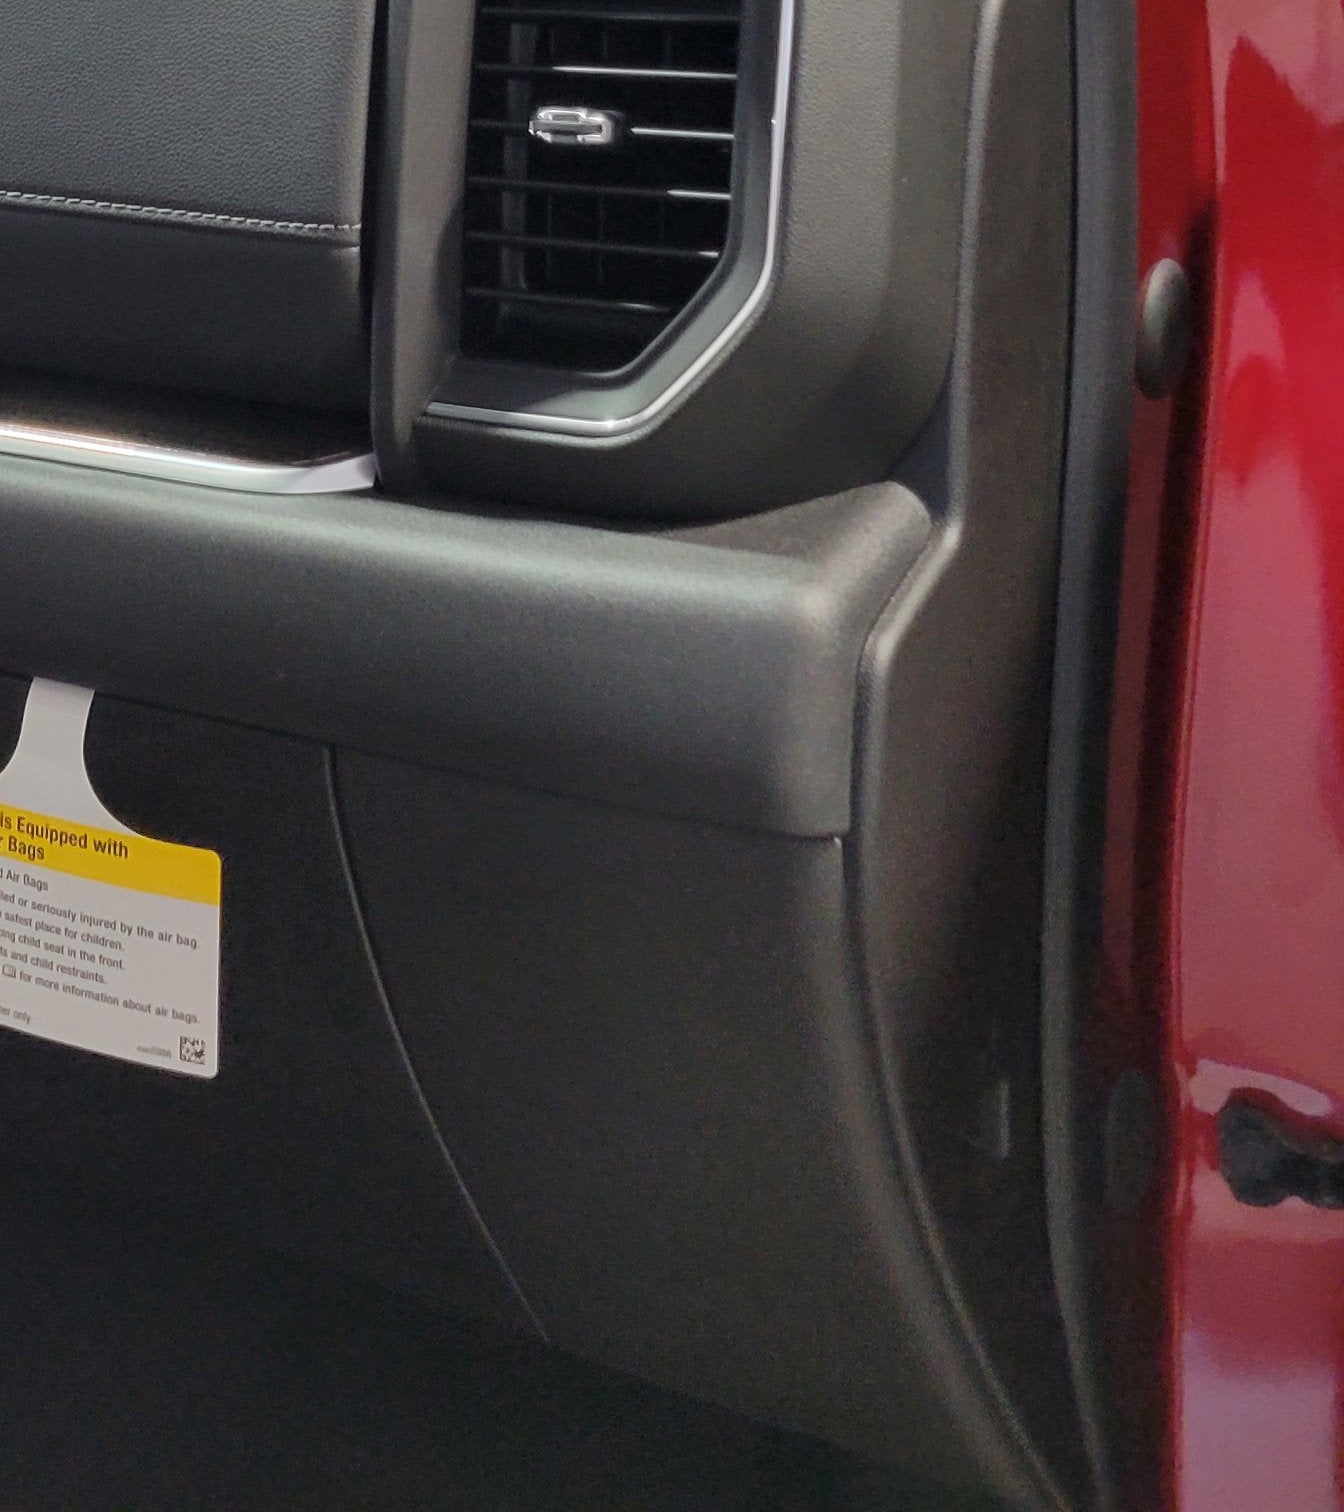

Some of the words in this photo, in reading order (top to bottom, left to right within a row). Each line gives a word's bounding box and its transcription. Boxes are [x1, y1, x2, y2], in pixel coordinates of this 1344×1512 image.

[8, 835, 45, 861] Bags
[17, 816, 88, 849] Equipped
[93, 839, 128, 859] with
[6, 869, 20, 883] Air
[23, 874, 49, 892] Bags
[5, 912, 32, 927] safest
[35, 919, 61, 935] place
[64, 927, 78, 939] for
[81, 932, 125, 951] children.
[18, 898, 28, 907] or
[31, 900, 77, 922] seriously
[80, 912, 116, 932] injured
[120, 922, 133, 936] by
[137, 926, 154, 939] the
[158, 931, 173, 943] air
[176, 933, 201, 950] bag.
[10, 951, 28, 964] and
[30, 956, 54, 971] child
[56, 964, 107, 985] restraints.
[18, 933, 40, 948] child
[44, 941, 64, 954] seat
[67, 947, 76, 958] in
[80, 950, 95, 963] the
[99, 955, 126, 970] front.
[19, 970, 32, 982] for
[35, 976, 59, 991] more
[62, 984, 119, 1006] information
[122, 998, 151, 1014] about
[155, 1006, 169, 1017] air
[172, 1008, 200, 1025] bags.
[12, 1011, 32, 1025] only
